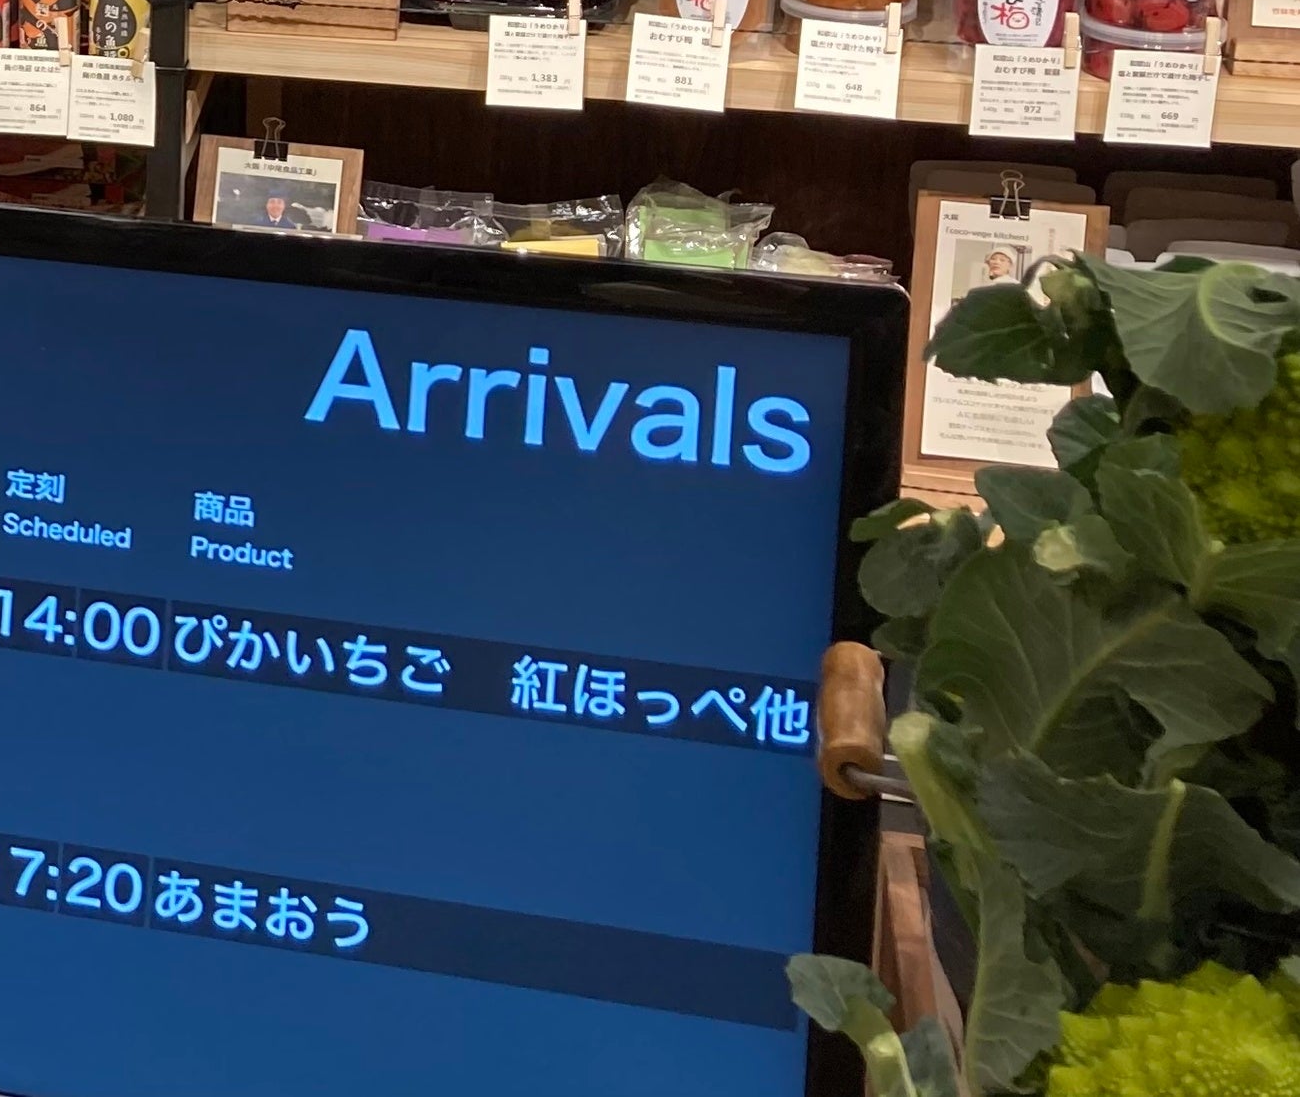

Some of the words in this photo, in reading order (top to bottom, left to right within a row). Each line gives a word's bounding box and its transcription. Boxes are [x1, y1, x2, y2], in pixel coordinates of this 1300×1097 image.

[531, 73, 558, 83] 1,383
[674, 76, 693, 86] 881
[845, 82, 863, 92] 648
[29, 103, 46, 111] 864
[1024, 105, 1042, 114] 972
[109, 112, 134, 122] 1,080
[1161, 111, 1179, 120] 669
[304, 328, 812, 474] Arrivals
[4, 469, 65, 503] 定刻
[193, 491, 255, 527] 商品
[2, 511, 132, 551] Scheduled
[190, 536, 294, 572] Product
[174, 611, 452, 697] ぴかいちご
[510, 653, 811, 746] 紅ほっぺ他
[155, 869, 370, 948] あまおう
